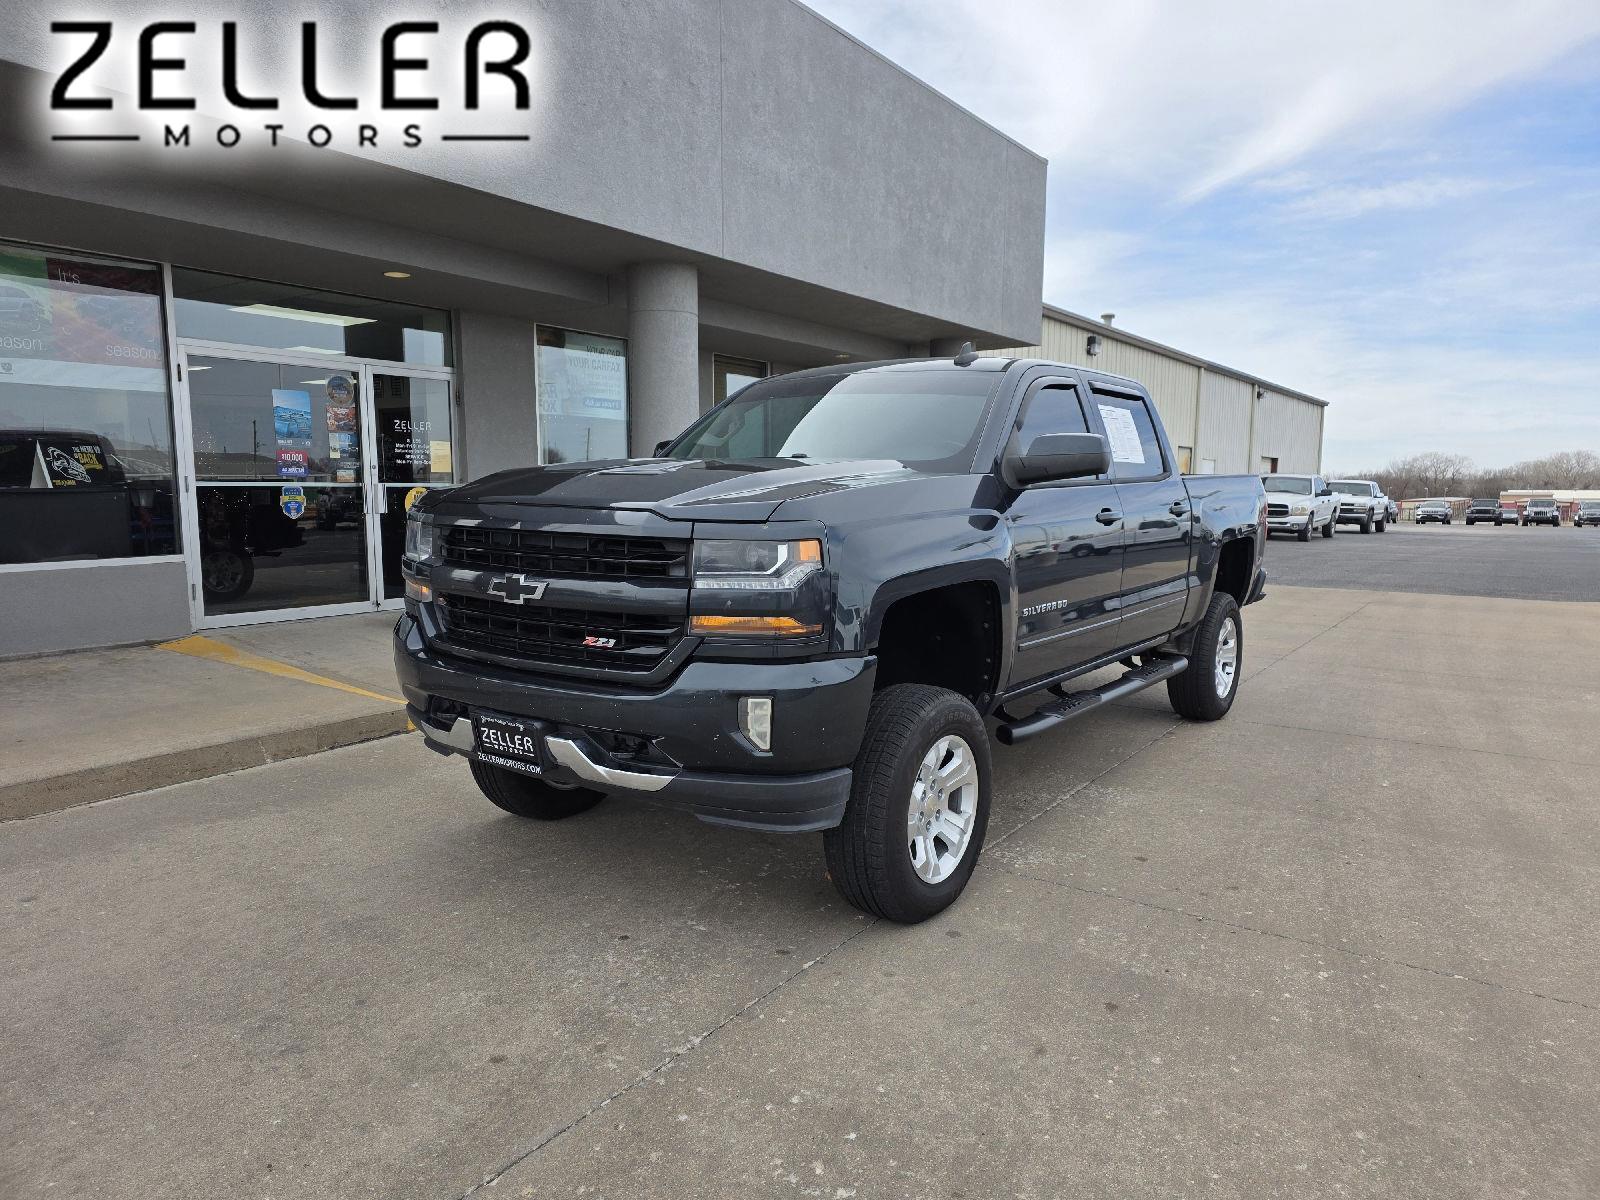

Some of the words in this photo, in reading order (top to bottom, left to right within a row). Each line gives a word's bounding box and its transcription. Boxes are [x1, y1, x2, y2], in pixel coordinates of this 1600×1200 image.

[58, 267, 81, 286] It's
[567, 356, 590, 370] YOUR
[592, 361, 621, 374] CARFAX
[394, 419, 432, 430] ZELLER
[78, 453, 98, 465] BACK
[1023, 600, 1068, 617] SILVERADO
[582, 636, 616, 648] Z71
[481, 727, 535, 752] ZELLER
[477, 752, 542, 775] ZELLERMOTORS.COM
